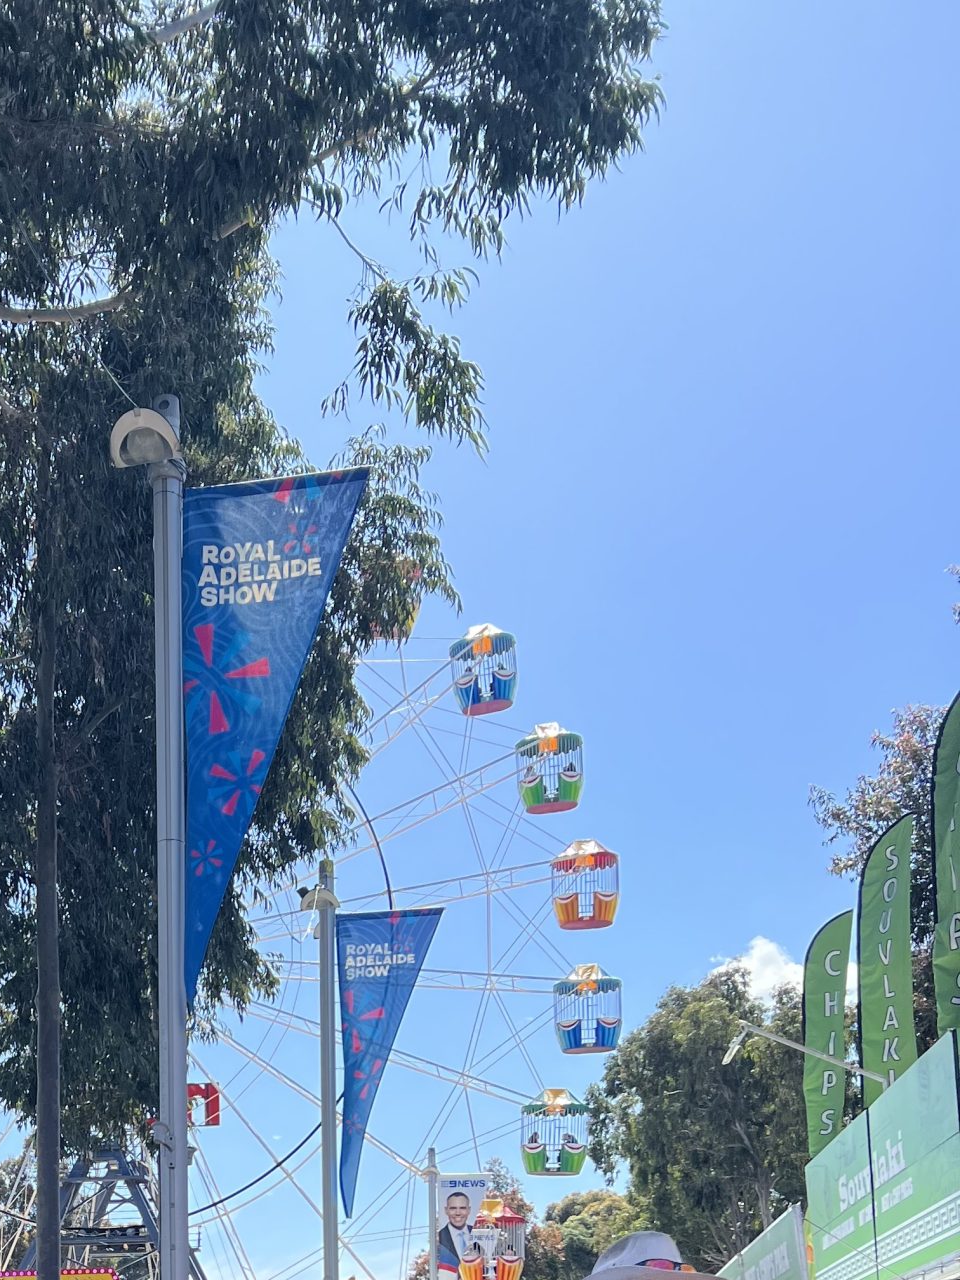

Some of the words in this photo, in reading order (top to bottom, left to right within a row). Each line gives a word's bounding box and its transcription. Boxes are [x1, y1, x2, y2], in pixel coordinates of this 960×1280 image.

[202, 540, 280, 564] ROYAL
[198, 557, 322, 587] ADELAIDE
[200, 581, 278, 607] SHOW
[346, 943, 392, 955] ROYAL
[345, 954, 416, 969] ADELAIDE
[346, 965, 390, 980] SHOW
[820, 950, 841, 1136] CHIPS
